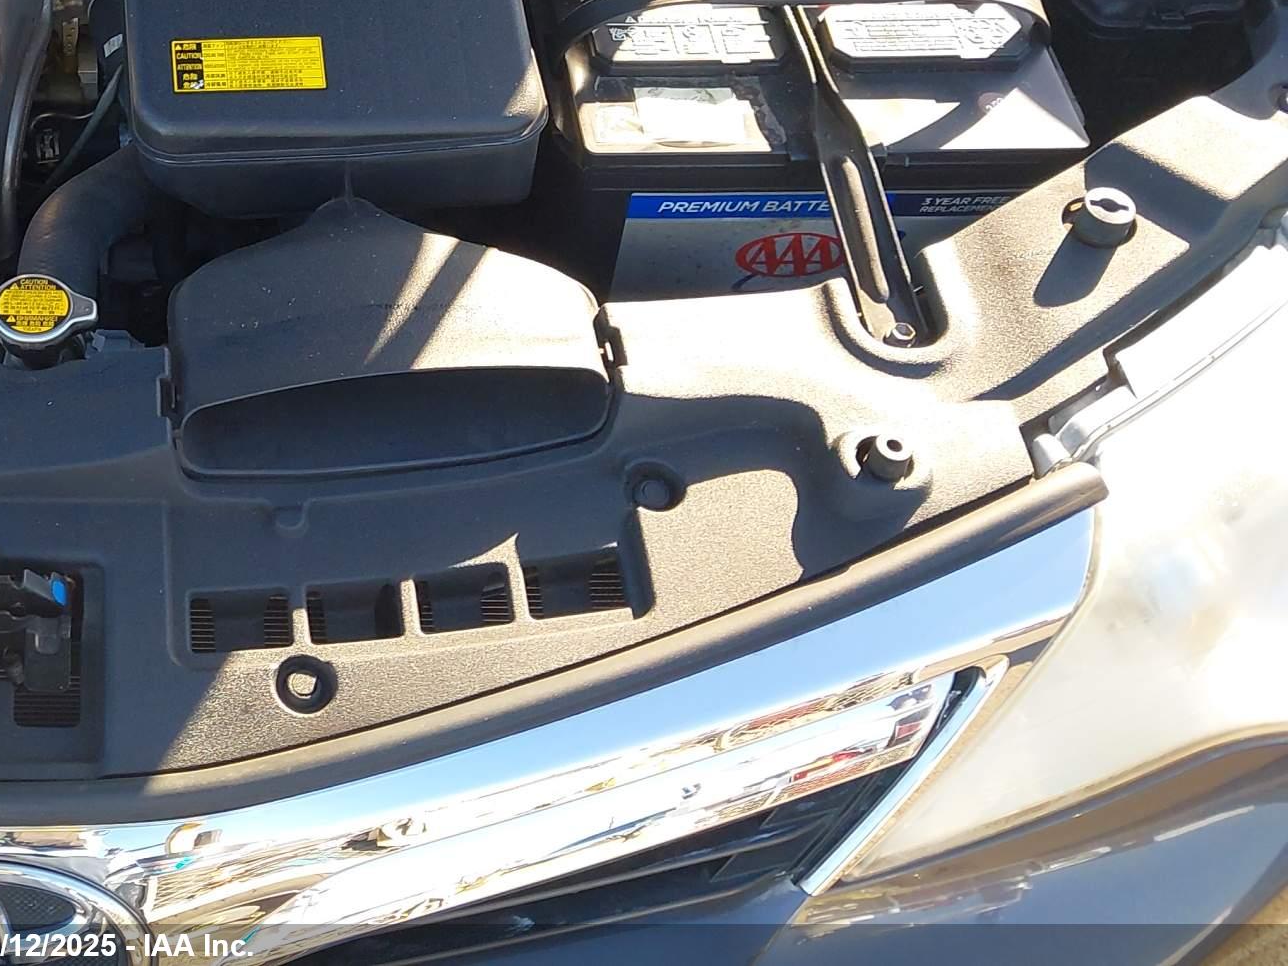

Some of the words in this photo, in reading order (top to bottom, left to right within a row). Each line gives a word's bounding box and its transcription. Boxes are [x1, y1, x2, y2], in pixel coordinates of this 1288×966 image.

[176, 52, 202, 60] CAUTION
[657, 201, 760, 214] PREMIUM
[762, 200, 830, 213] BATTE
[921, 197, 933, 206] 3
[934, 197, 972, 206] YEAR
[972, 196, 1012, 205] FREE
[745, 233, 838, 277] AAA
